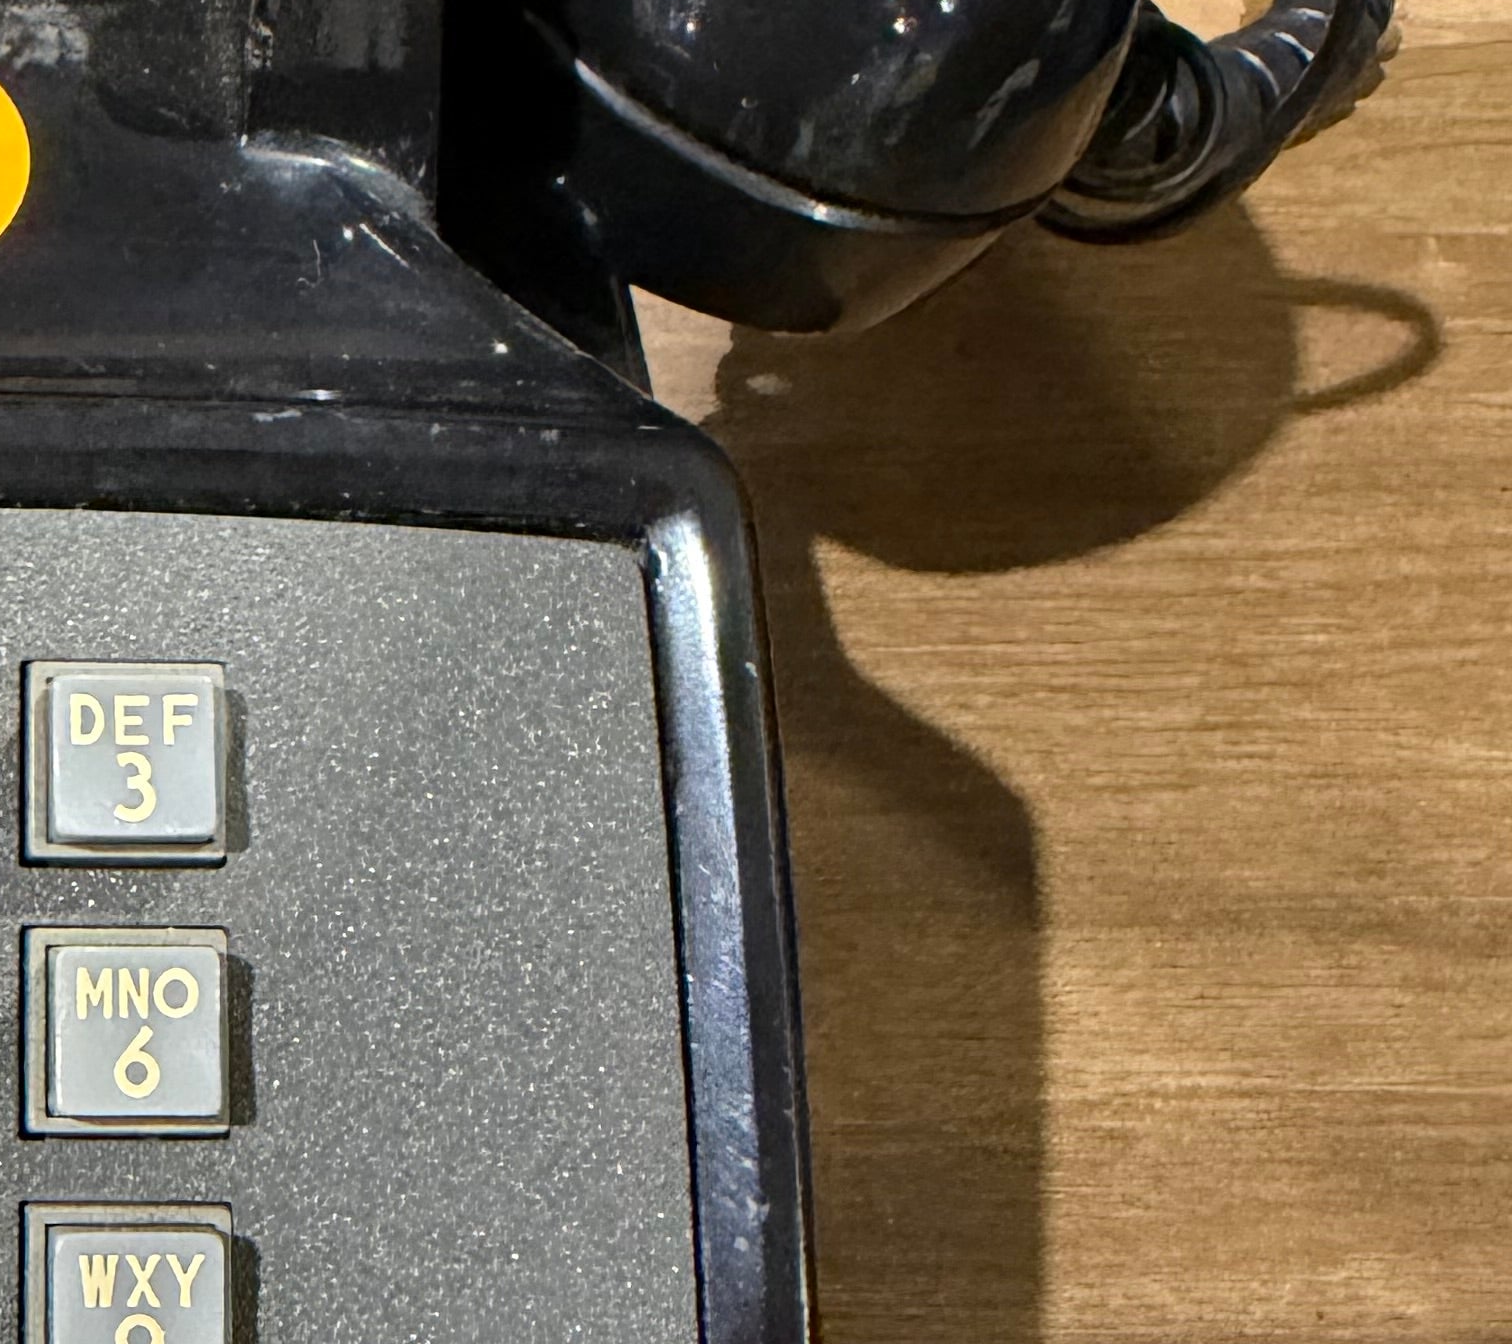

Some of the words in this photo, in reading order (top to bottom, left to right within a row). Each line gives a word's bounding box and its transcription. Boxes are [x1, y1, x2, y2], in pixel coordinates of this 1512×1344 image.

[69, 693, 199, 746] DEF
[112, 752, 157, 823] 3
[75, 966, 199, 1020] MNO
[113, 1026, 161, 1099] 6
[78, 1253, 207, 1309] WXY
